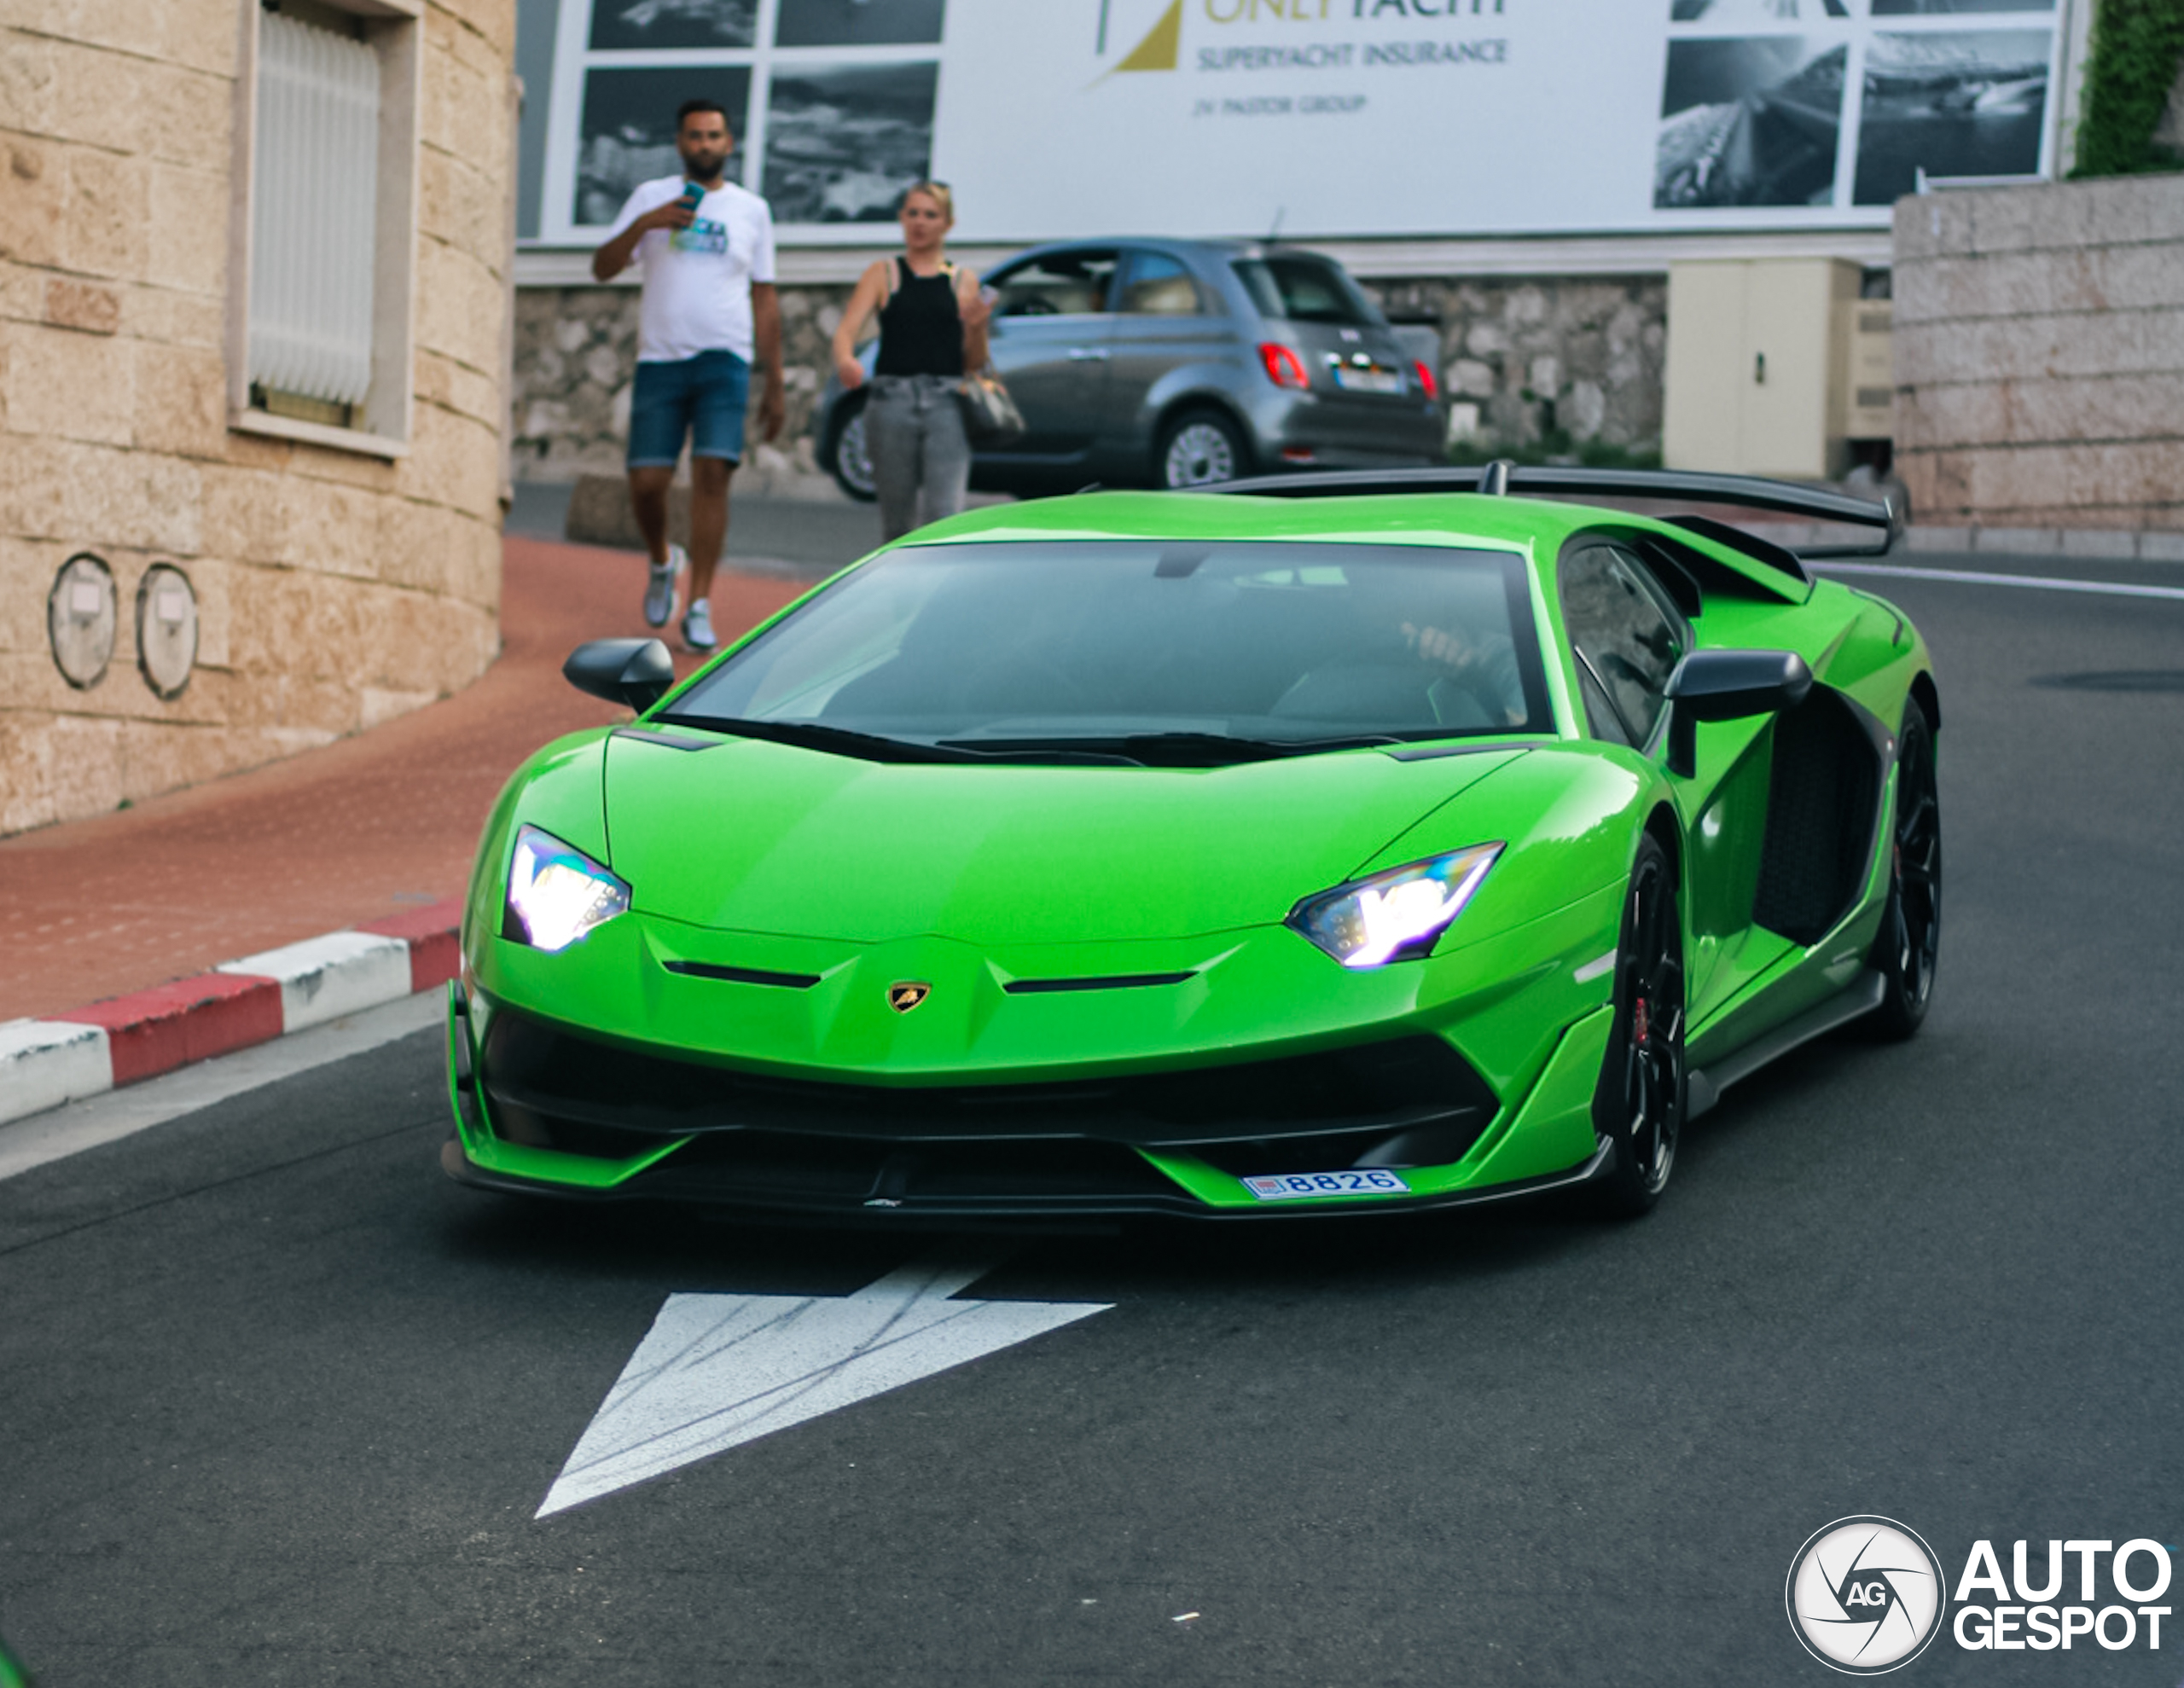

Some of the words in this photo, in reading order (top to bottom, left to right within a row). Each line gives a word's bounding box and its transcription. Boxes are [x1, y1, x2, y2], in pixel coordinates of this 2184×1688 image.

[1197, 44, 1353, 70] SUPERYACHT
[1364, 39, 1507, 66] INSURANCE
[1299, 95, 1367, 113] GROUP
[1286, 1172, 1395, 1192] 8826
